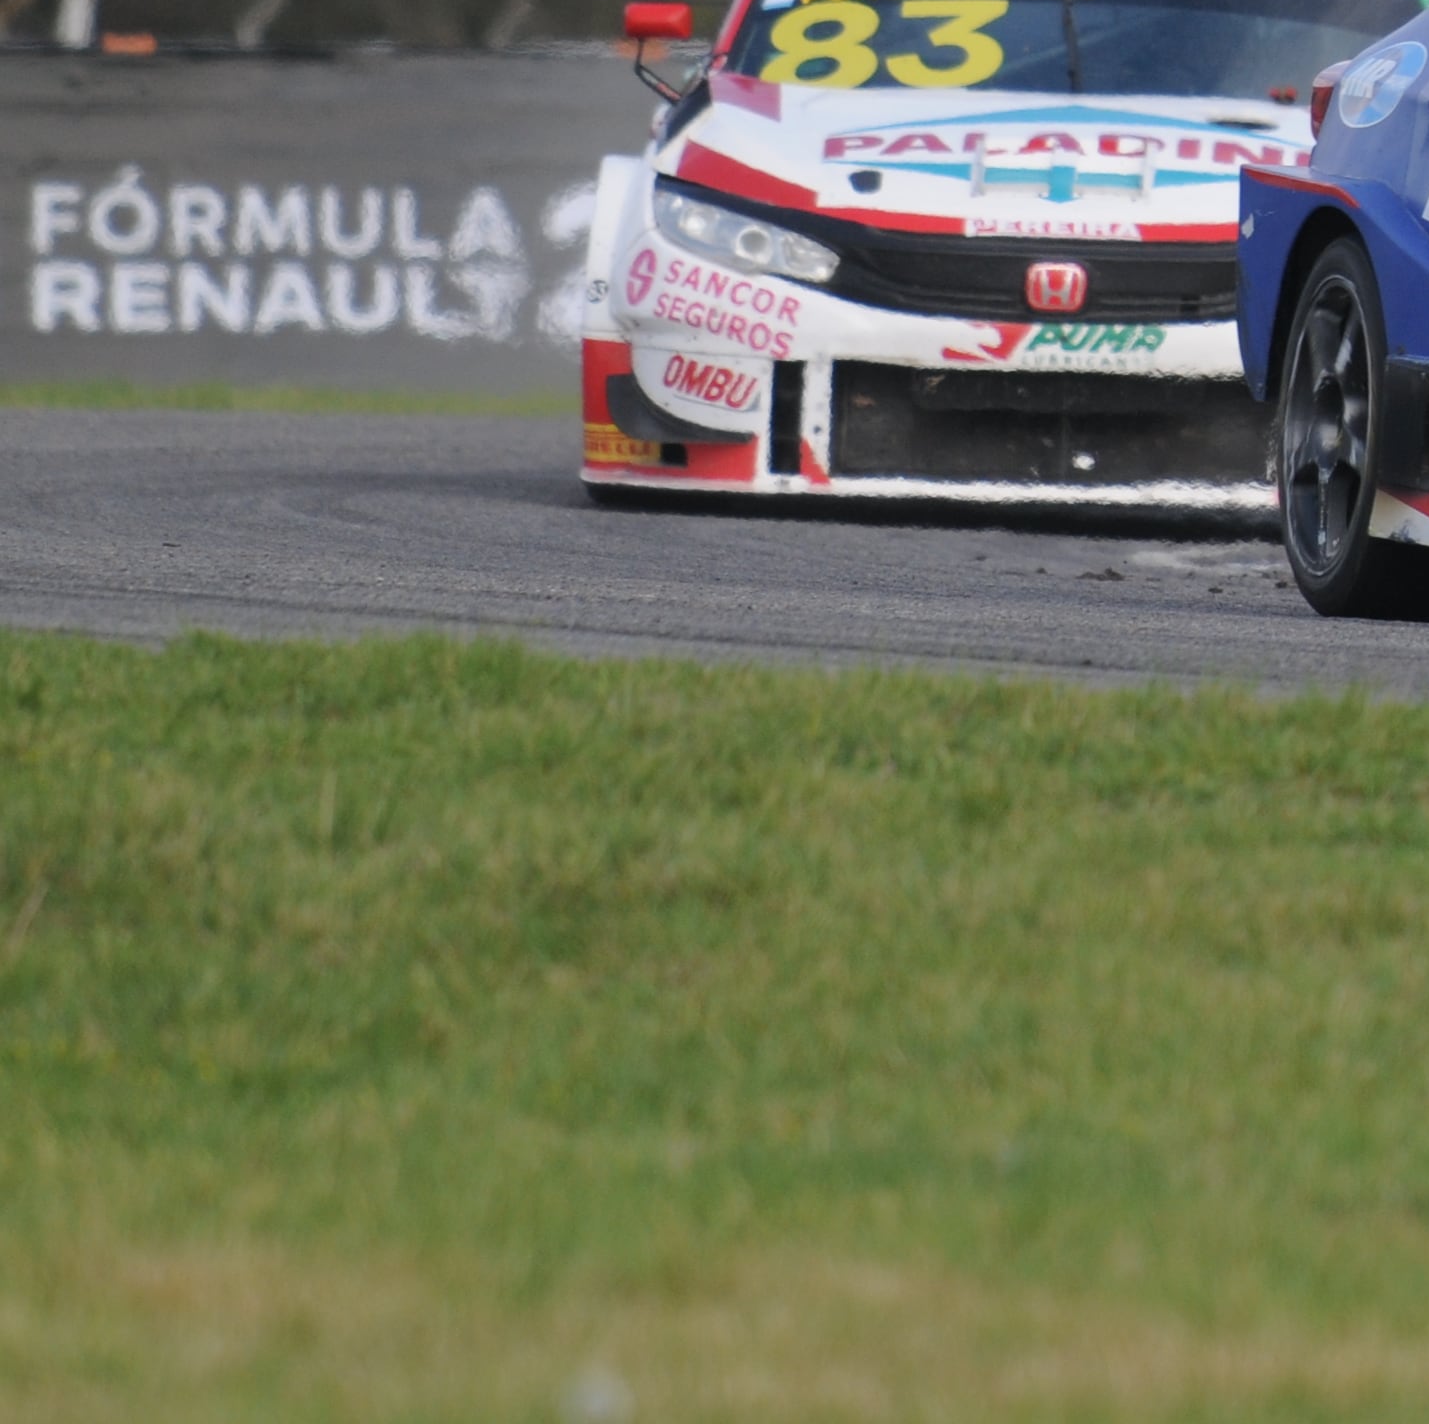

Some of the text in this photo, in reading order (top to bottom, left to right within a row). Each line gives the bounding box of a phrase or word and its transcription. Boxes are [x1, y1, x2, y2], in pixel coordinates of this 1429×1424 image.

[30, 163, 525, 262] FÓRMULA
[30, 260, 528, 343] RENAULT
[653, 292, 794, 359] SEGUROS
[664, 259, 800, 327] SANCOR
[1026, 324, 1167, 354] PUMA
[663, 354, 757, 409] OMBU
